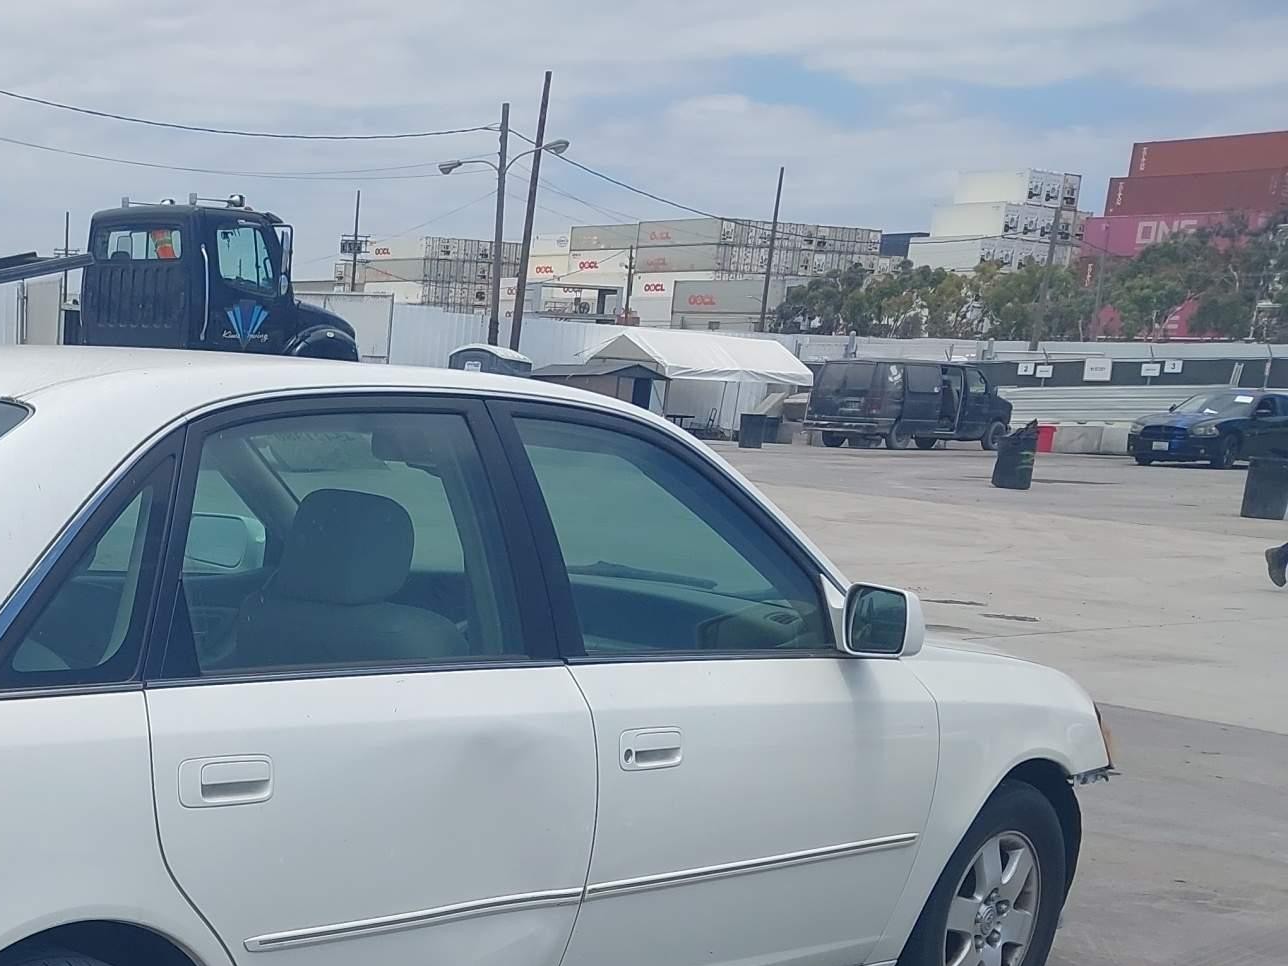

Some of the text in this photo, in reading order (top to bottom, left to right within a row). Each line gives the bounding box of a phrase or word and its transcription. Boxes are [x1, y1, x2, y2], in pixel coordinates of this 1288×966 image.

[1136, 219, 1198, 244] ONE
[374, 247, 391, 255] OOCL
[535, 266, 554, 274] OOCL
[578, 261, 599, 270] OOCL
[644, 283, 665, 292] OOCL
[688, 295, 716, 306] OOCL
